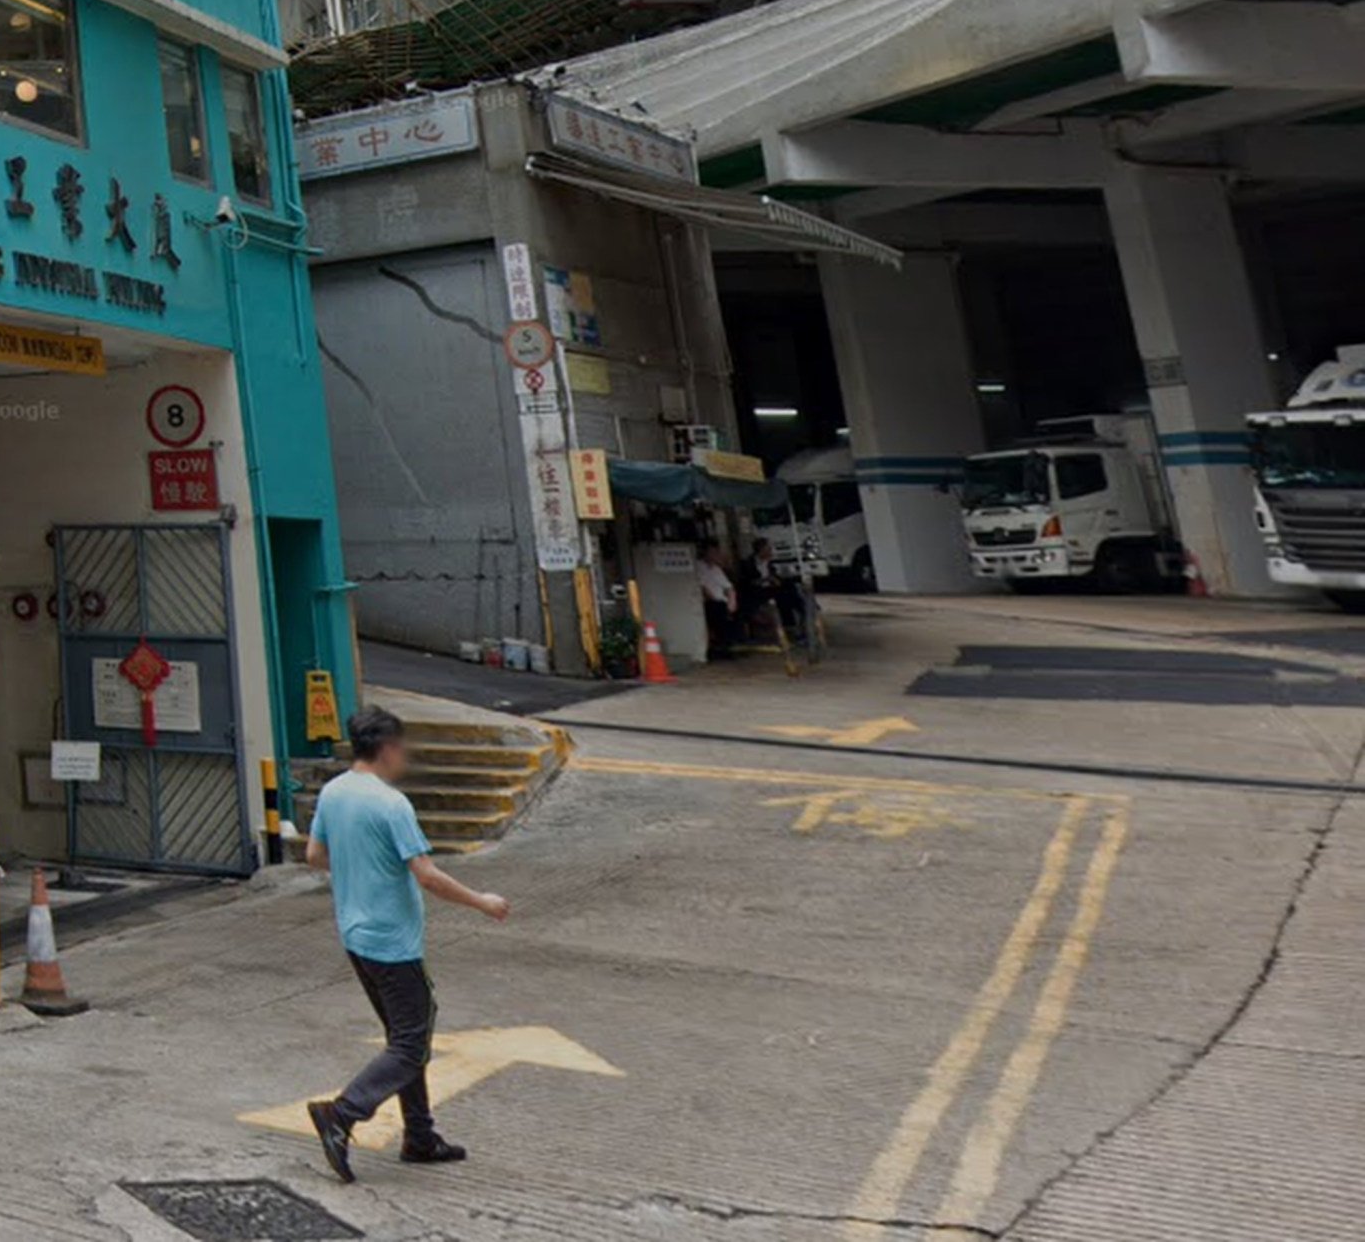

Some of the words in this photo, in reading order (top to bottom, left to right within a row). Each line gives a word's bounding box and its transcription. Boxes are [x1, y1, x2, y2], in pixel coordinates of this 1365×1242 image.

[166, 403, 185, 428] 8
[154, 457, 208, 474] SLOW
[160, 480, 208, 504] 慢駛
